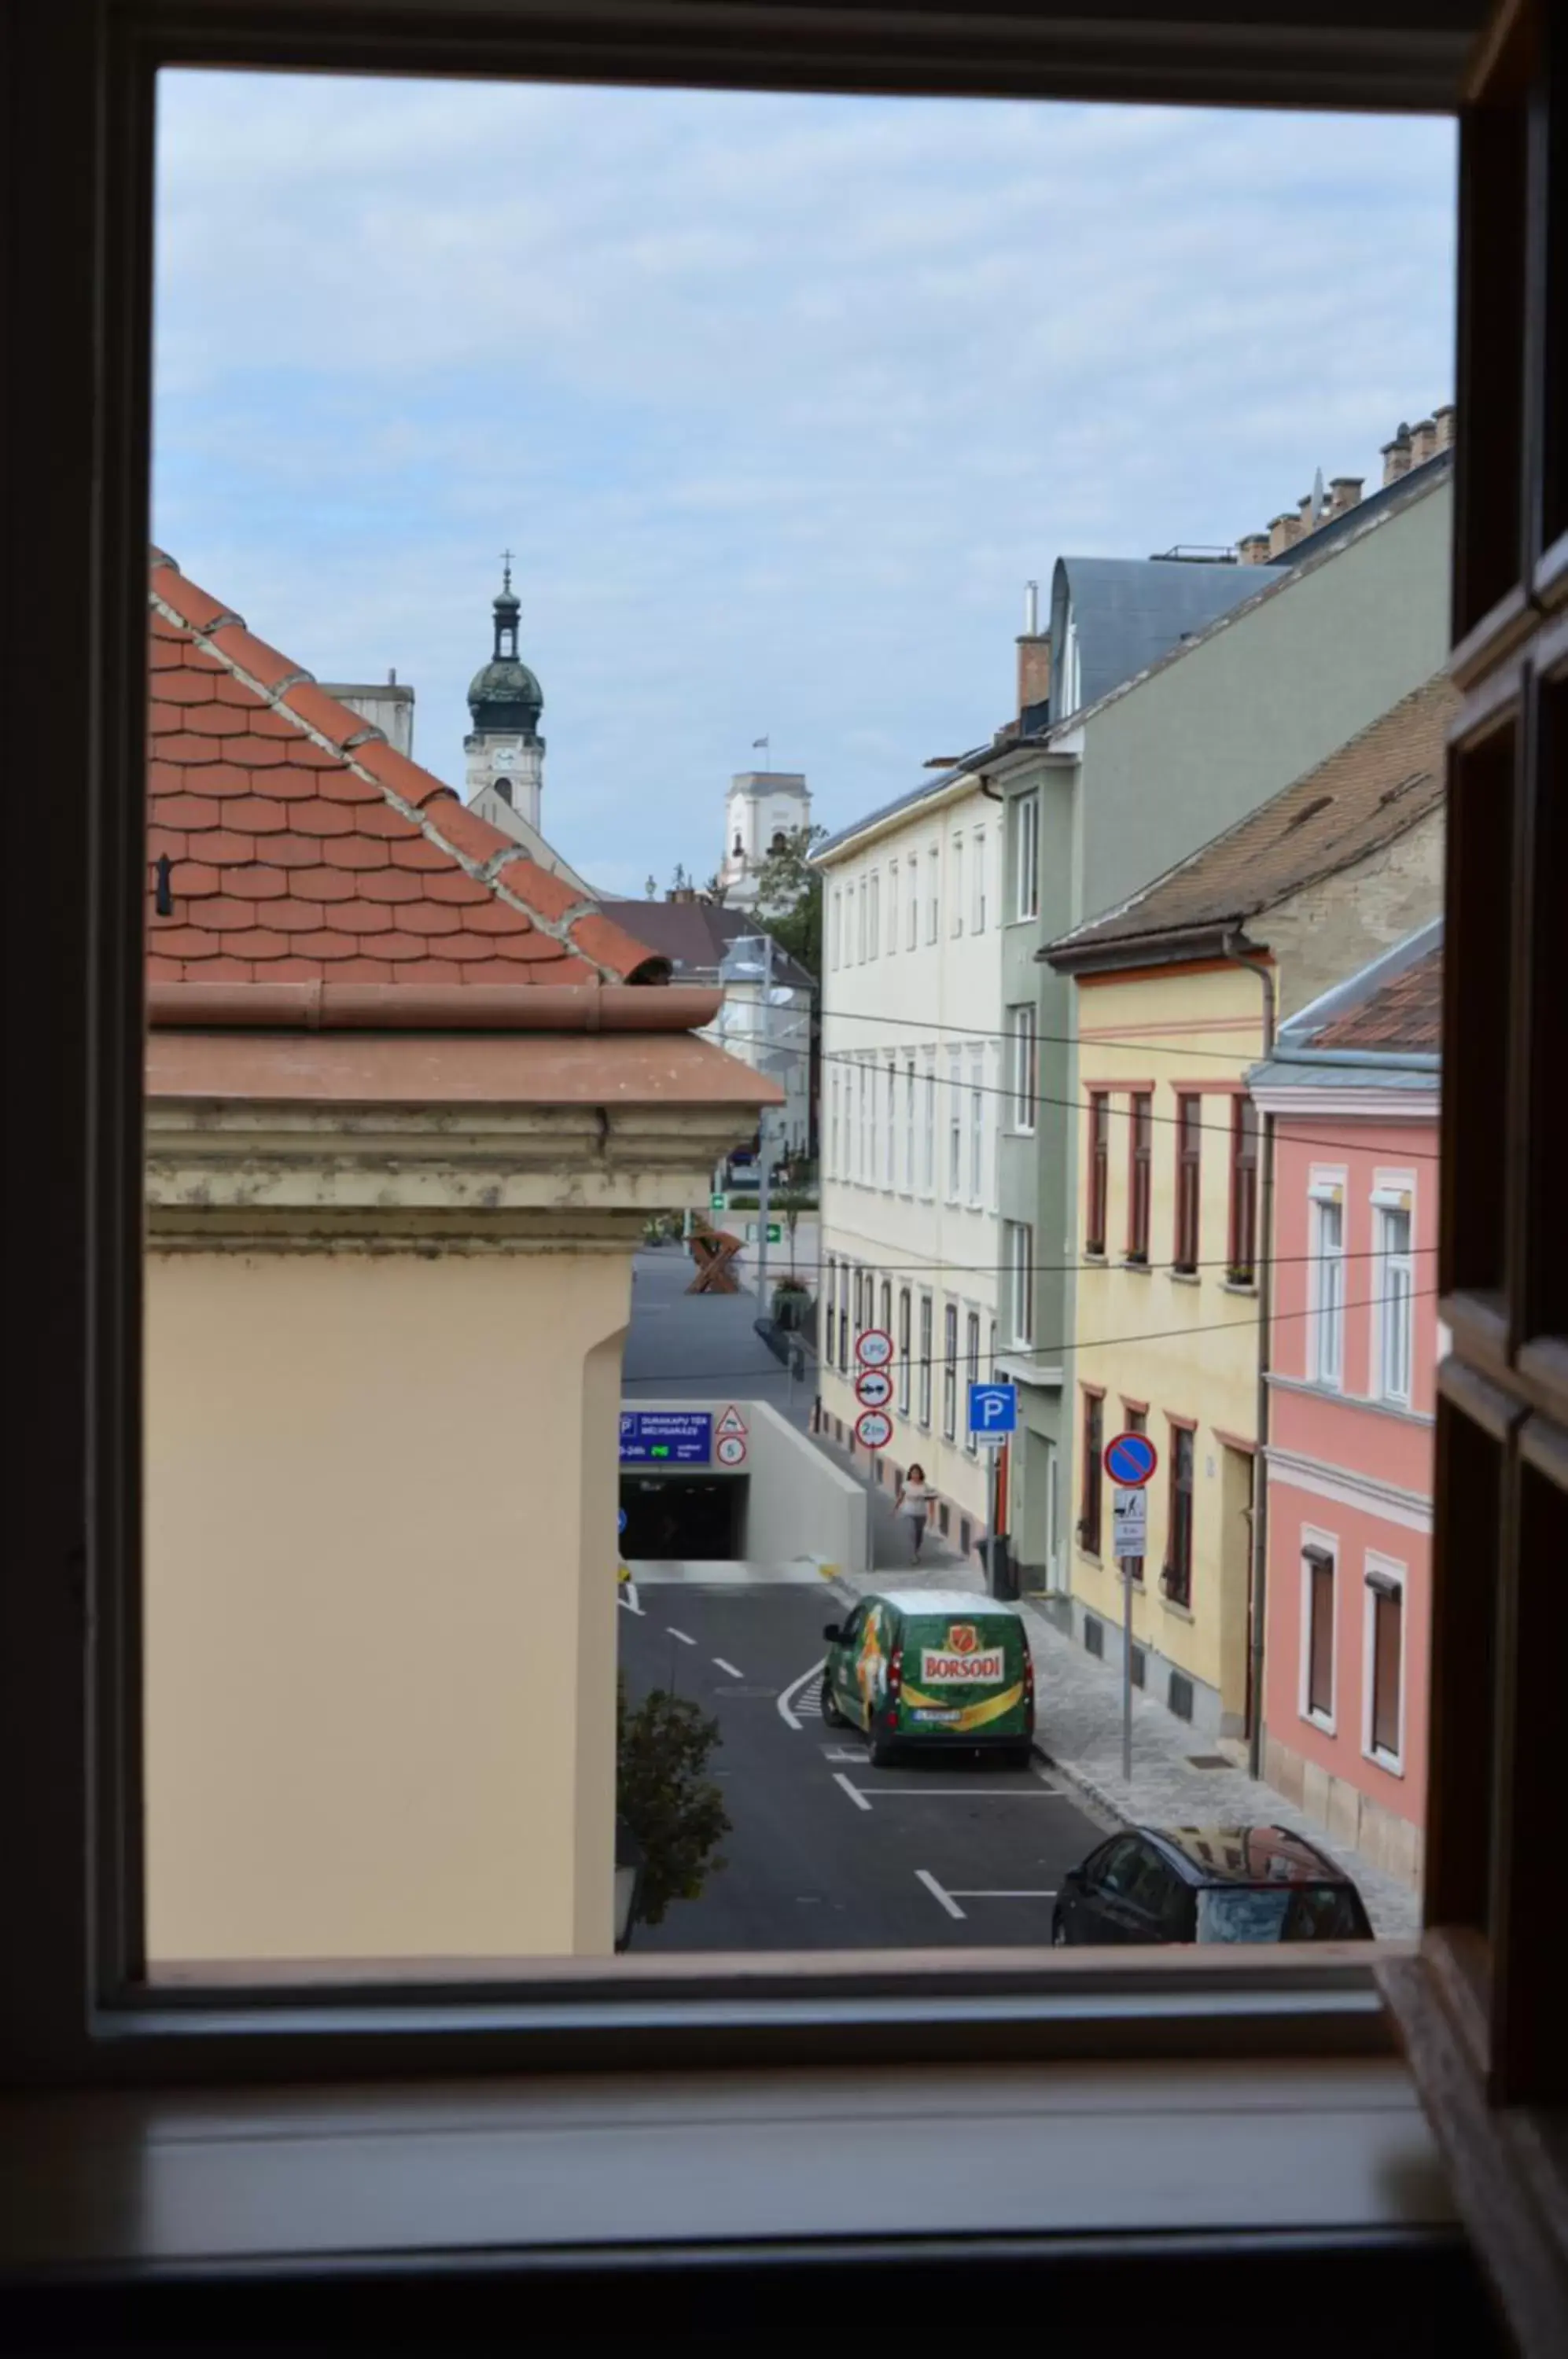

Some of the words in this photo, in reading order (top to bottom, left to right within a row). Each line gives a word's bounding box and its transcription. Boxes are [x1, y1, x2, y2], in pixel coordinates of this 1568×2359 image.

[863, 1343, 886, 1356] LPG
[984, 1399, 1004, 1427] P
[926, 1656, 999, 1678] BORSODI
